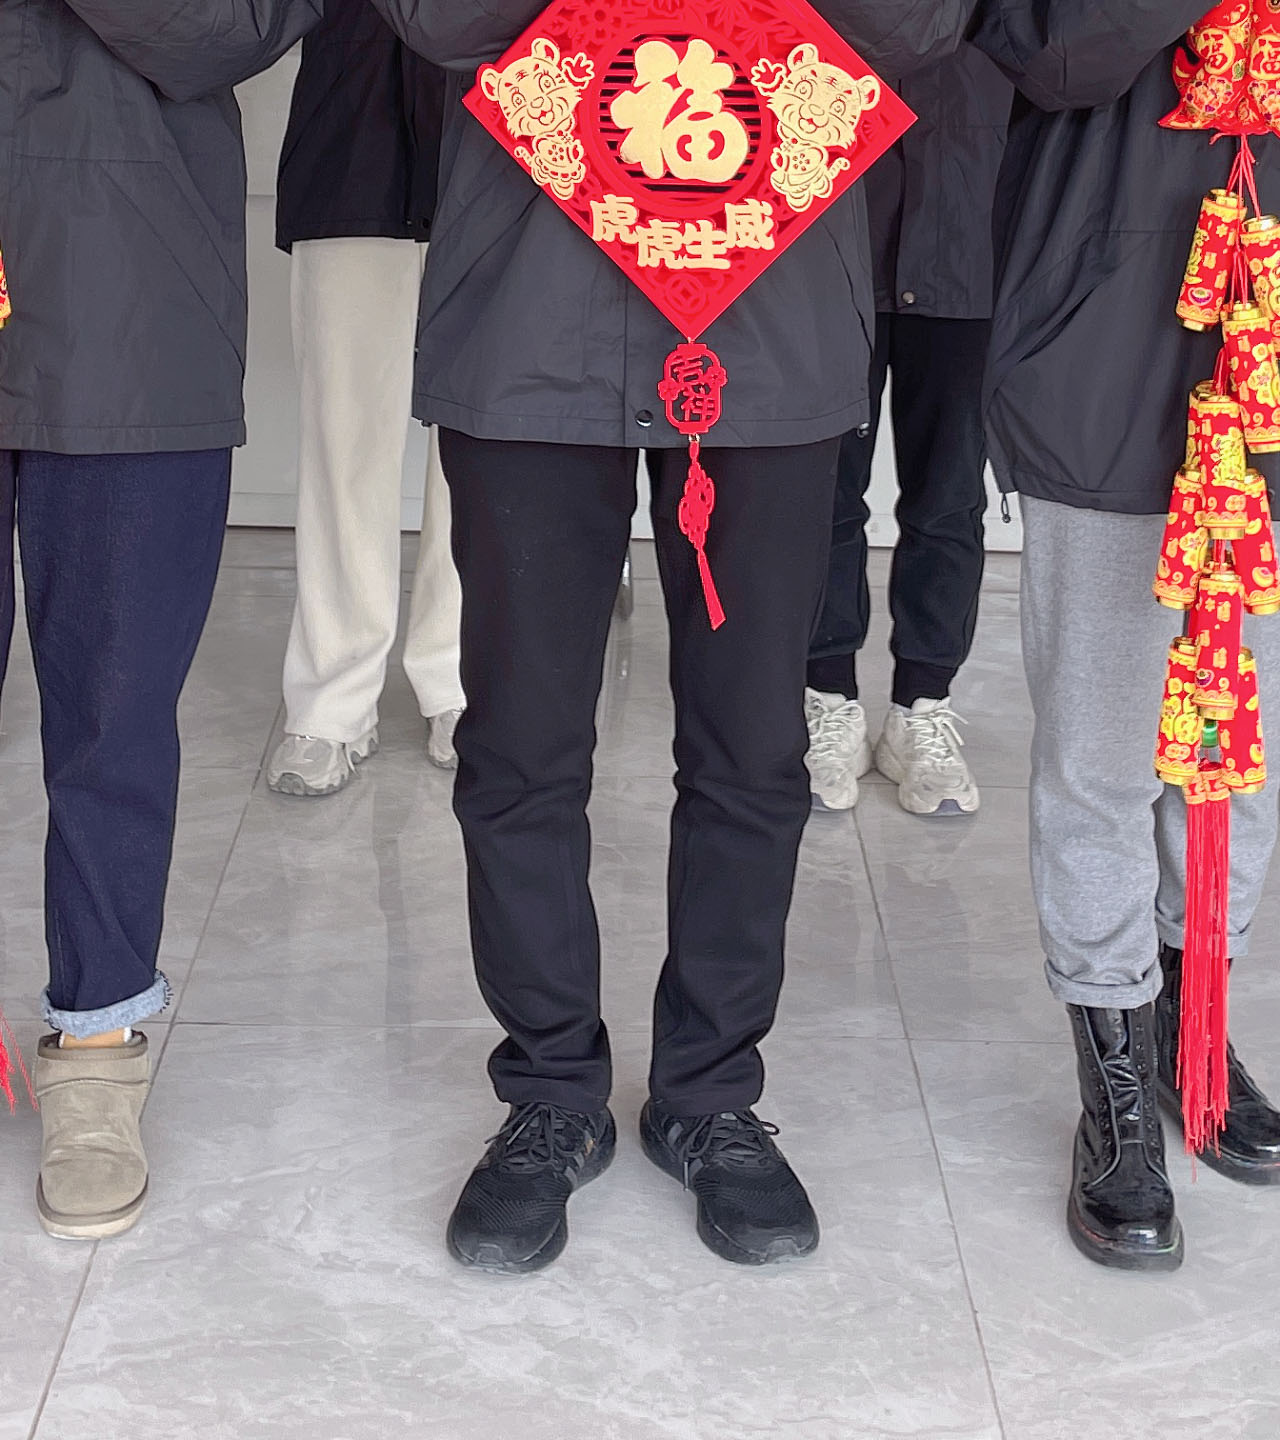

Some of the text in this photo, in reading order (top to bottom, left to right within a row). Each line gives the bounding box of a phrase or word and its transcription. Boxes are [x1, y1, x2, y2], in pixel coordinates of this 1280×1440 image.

[611, 38, 748, 181] 福
[591, 194, 775, 270] 虎虎生威
